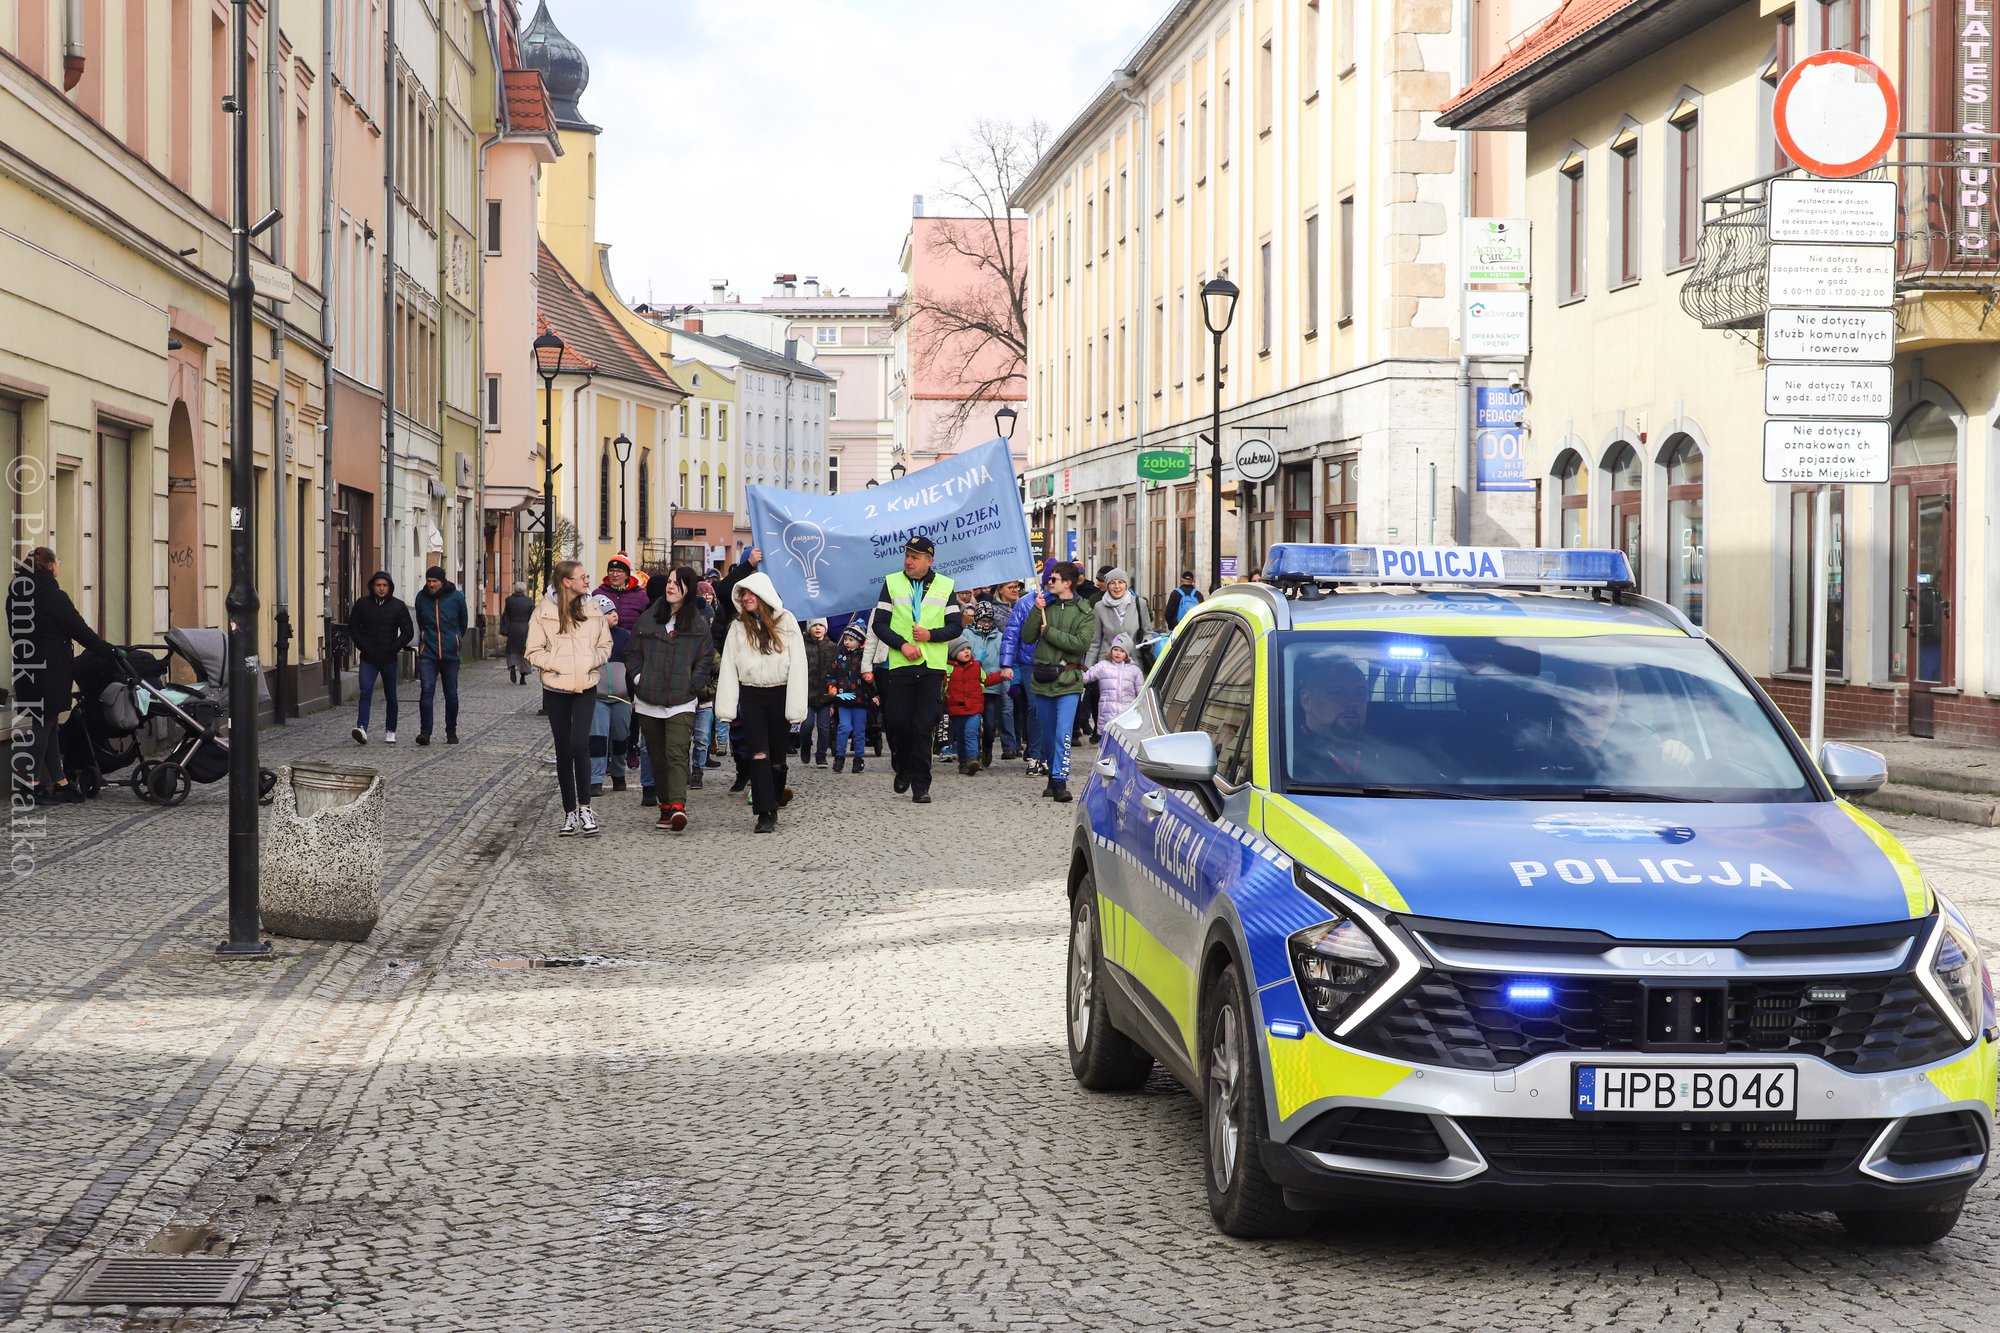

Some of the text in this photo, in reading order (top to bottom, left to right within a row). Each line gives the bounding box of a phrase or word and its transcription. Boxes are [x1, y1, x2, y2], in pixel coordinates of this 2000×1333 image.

[1828, 187, 1854, 195] dotyczy
[1959, 122, 1989, 251] STUDIO
[1473, 245, 1522, 260] Active 24
[1479, 253, 1504, 264] Care
[1827, 255, 1858, 264] dotyczy
[1483, 309, 1524, 318] activecare
[1796, 315, 1866, 327] Nie dotyczy
[1774, 328, 1887, 342] służb komunalnych
[1810, 344, 1859, 353] rowerów
[1785, 381, 1873, 392] Nie dotyczy TAXI
[1793, 426, 1862, 437] Nie dotyczy
[1143, 456, 1185, 469] żabka
[1238, 452, 1273, 467] cukru
[1781, 467, 1813, 479] Służb
[864, 504, 878, 520] 2
[887, 464, 994, 513] KWIETNIA
[870, 498, 1000, 547] ŚWIATOWY DZIEŃ
[951, 520, 1001, 542] AUTYZMU
[938, 546, 1018, 571] SZKOLNO-WYCHOWAWCZY
[1383, 550, 1499, 578] POLICJA
[1155, 809, 1205, 891] POLICJA
[1509, 858, 1794, 890] POLICJA
[1580, 1073, 1784, 1109] PL HPB B046
